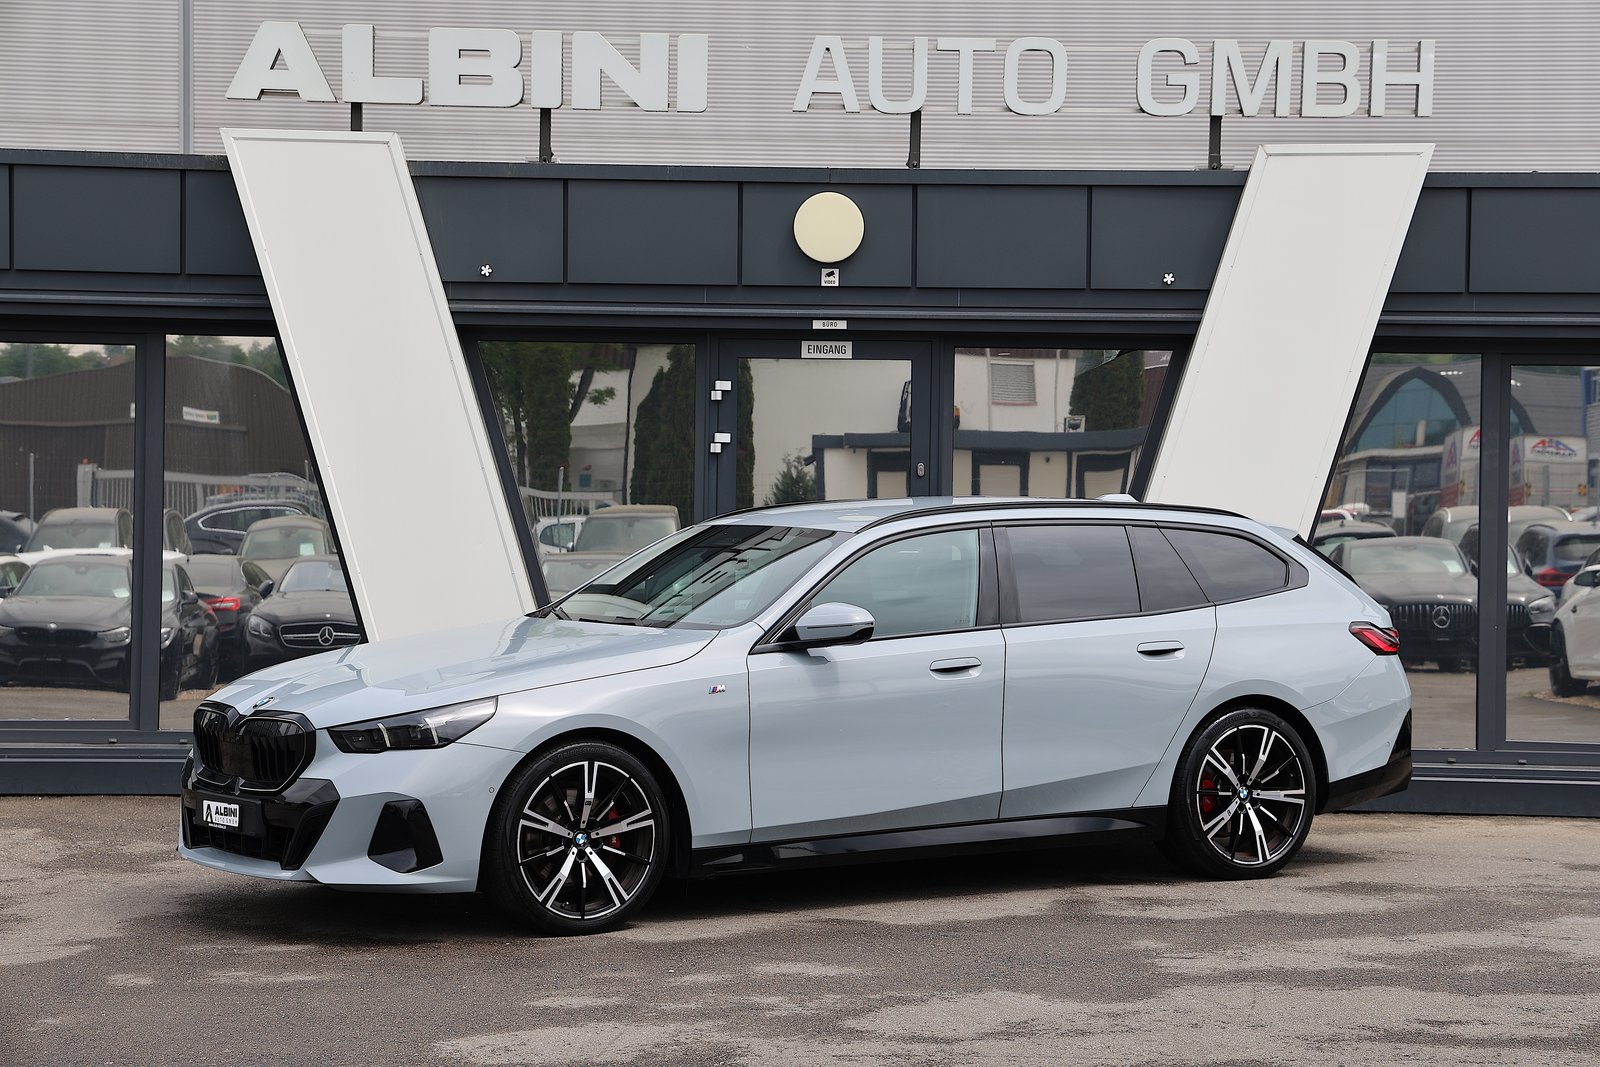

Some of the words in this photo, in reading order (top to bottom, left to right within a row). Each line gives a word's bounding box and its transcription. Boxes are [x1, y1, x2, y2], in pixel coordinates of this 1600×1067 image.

[225, 21, 708, 112] ALBINI
[792, 35, 1068, 116] AUTO
[1136, 37, 1436, 118] GMBH
[807, 344, 847, 355] EINGANG
[214, 806, 238, 818] ALBINI
